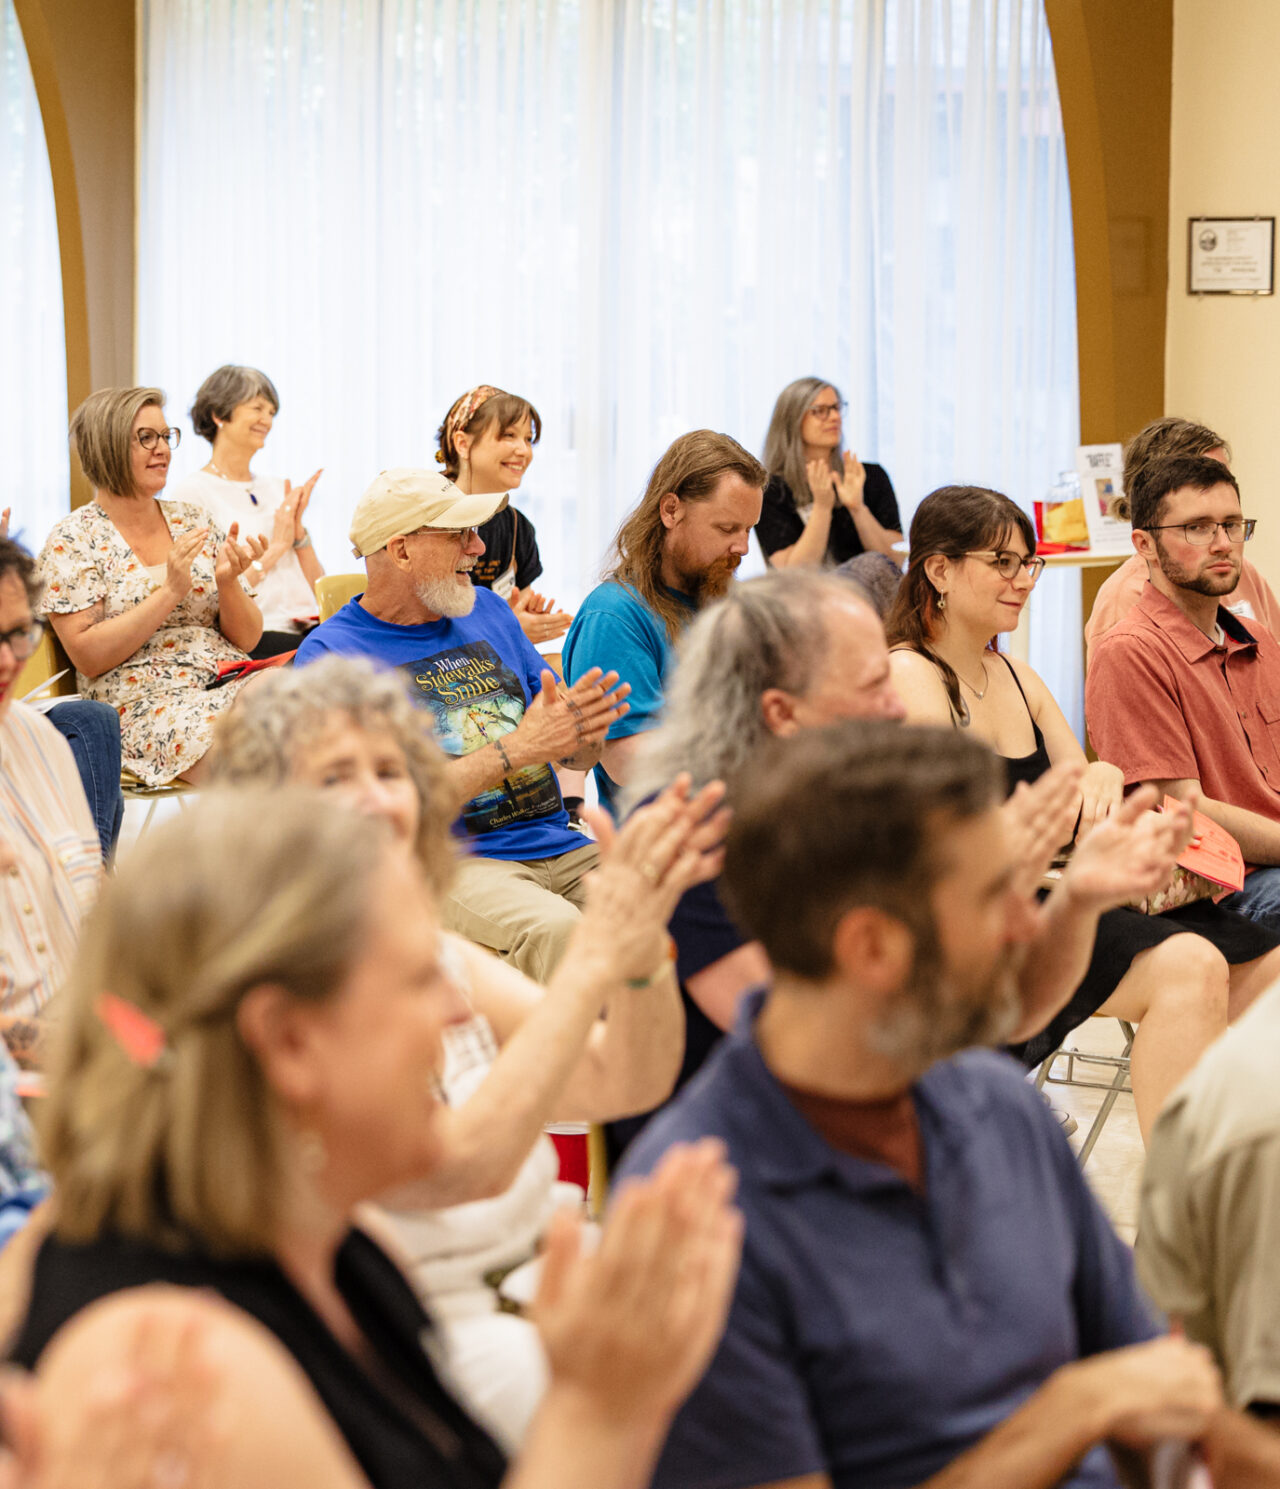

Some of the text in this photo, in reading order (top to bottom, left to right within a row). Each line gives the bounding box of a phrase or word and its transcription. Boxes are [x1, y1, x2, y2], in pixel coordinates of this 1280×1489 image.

[415, 657, 496, 691] Sidewalks
[433, 657, 471, 673] When
[437, 675, 500, 705] Smile
